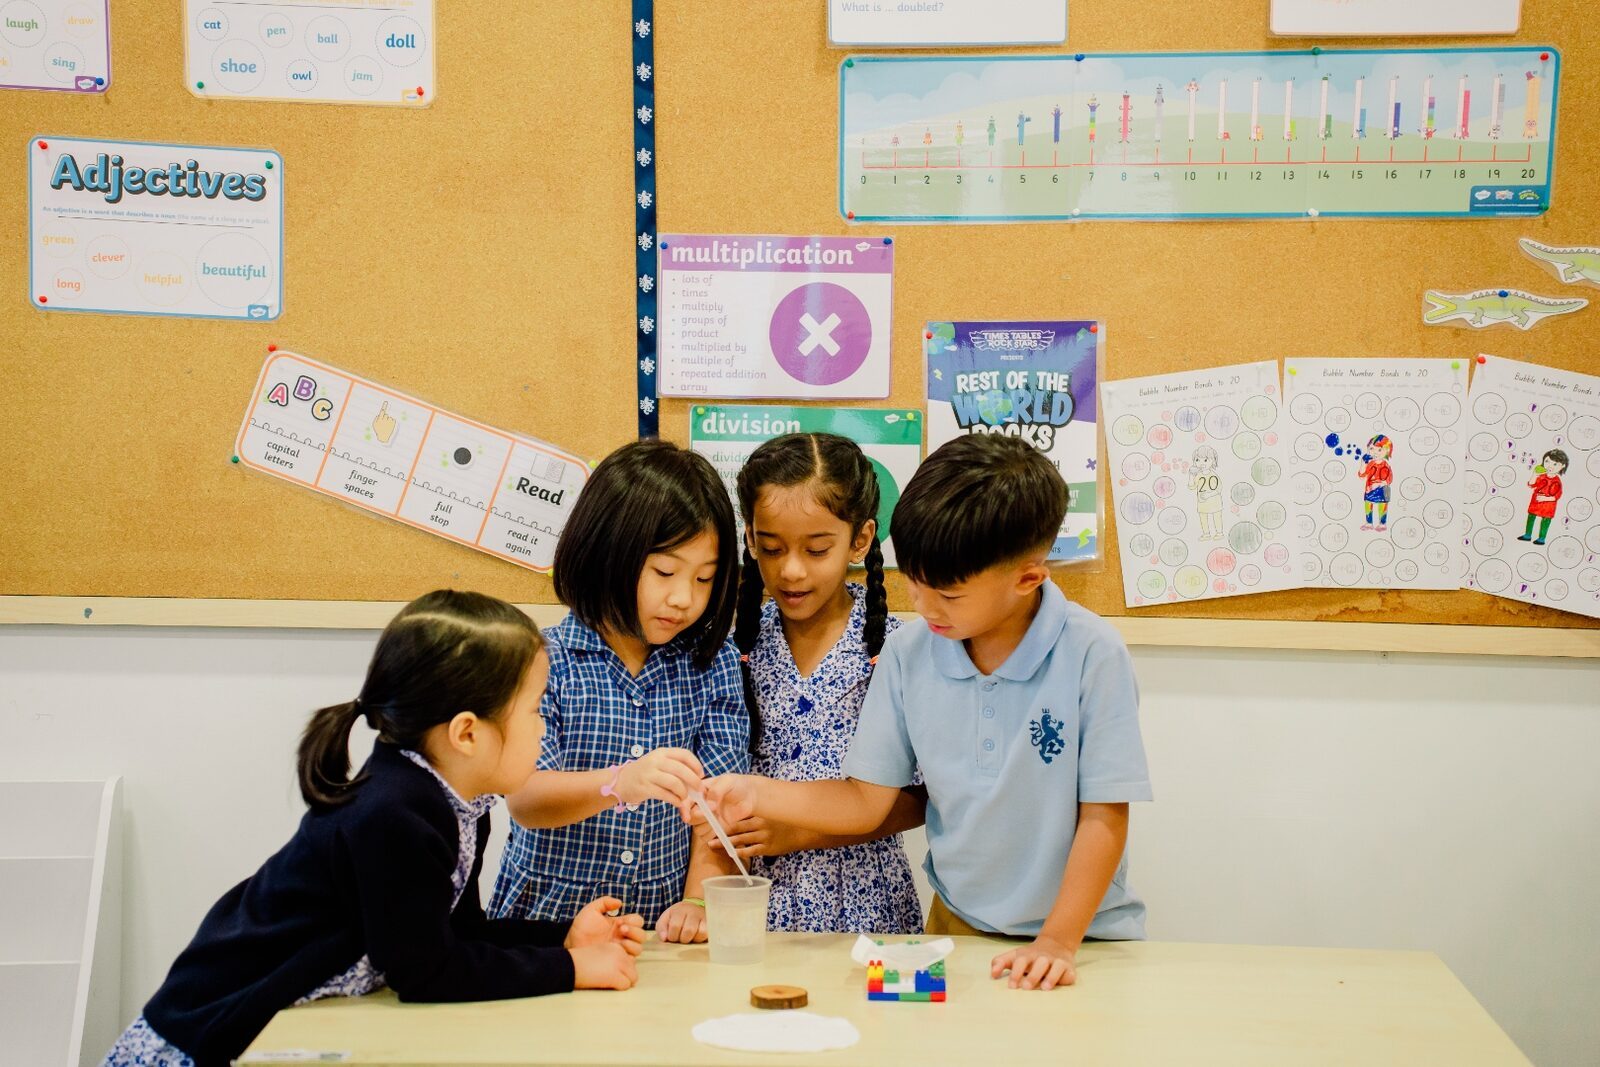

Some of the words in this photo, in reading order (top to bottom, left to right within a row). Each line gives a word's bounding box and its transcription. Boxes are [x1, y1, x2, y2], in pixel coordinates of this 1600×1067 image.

[841, 2, 870, 12] What
[873, 2, 881, 12] is
[897, 1, 945, 12] doubled?
[6, 17, 39, 32] laugh
[67, 16, 94, 25] draw
[203, 20, 222, 30] cat
[266, 26, 287, 38] pen
[317, 33, 338, 45] ball
[385, 33, 416, 49] doll
[52, 56, 76, 72] sing
[220, 58, 257, 74] shoe
[291, 70, 312, 81] owl
[351, 69, 373, 82] jam
[51, 153, 266, 204] Adjectives
[861, 175, 867, 185] 0
[893, 175, 897, 185] 1
[924, 174, 931, 185] 2
[956, 174, 962, 185] 3
[987, 175, 994, 184] 4
[1019, 174, 1026, 184] 5
[1052, 174, 1059, 184] 6
[1088, 171, 1095, 182] 7
[1121, 171, 1127, 182] 8
[1153, 171, 1160, 182] 9
[1184, 171, 1196, 182] 10
[1217, 171, 1228, 182] 11
[1250, 170, 1262, 181] 12
[1283, 170, 1295, 181] 13
[1318, 169, 1331, 180] 14
[1351, 169, 1364, 180] 15
[1385, 169, 1398, 180] 16
[1419, 169, 1432, 180] 17
[1453, 169, 1466, 179] 18
[1488, 168, 1501, 179] 19
[1521, 168, 1536, 179] 20
[42, 235, 75, 245] green
[92, 253, 125, 263] clever
[672, 241, 853, 269] multiplication
[202, 262, 266, 281] beautiful
[57, 279, 81, 292] long
[144, 273, 183, 287] helpful
[682, 274, 700, 284] lots
[703, 274, 713, 286] of
[681, 289, 709, 297] times
[681, 302, 724, 313] multiply
[681, 316, 714, 327] groups
[717, 314, 728, 327] of
[681, 329, 719, 341] product
[983, 332, 1009, 340] TIMES
[1011, 332, 1042, 340] TABLES
[681, 342, 732, 353] multiplied
[734, 343, 747, 354] by
[988, 339, 1013, 348] ROCK
[1014, 340, 1038, 348] STARS
[681, 355, 722, 366] multiple
[724, 355, 735, 367] of
[681, 369, 723, 380] repeated
[725, 370, 767, 379] addition
[1322, 369, 1344, 377] Bubble
[1349, 369, 1374, 377] Number
[1380, 369, 1399, 377] Bonds
[1405, 369, 1411, 377] to
[1417, 369, 1428, 377] 20
[956, 371, 1000, 393] REST
[1006, 370, 1028, 390] OF
[1036, 371, 1070, 392] THE
[1164, 384, 1188, 392] Number
[1230, 375, 1241, 385] 20
[1514, 372, 1535, 384] Bubble
[1541, 378, 1567, 390] Number
[1573, 384, 1592, 395] Bonds
[680, 384, 708, 393] array
[951, 388, 1074, 427] WORLD
[702, 412, 800, 434] division
[266, 440, 300, 458] capital
[264, 451, 294, 469] letters
[348, 469, 378, 486] finger
[1368, 465, 1390, 483] 20
[1199, 475, 1219, 492] 20
[344, 482, 375, 499] spaces
[516, 476, 564, 506] Read
[434, 501, 453, 514] full
[430, 514, 449, 527] stop
[507, 529, 529, 542] read
[530, 535, 538, 545] it
[505, 542, 532, 556] again
